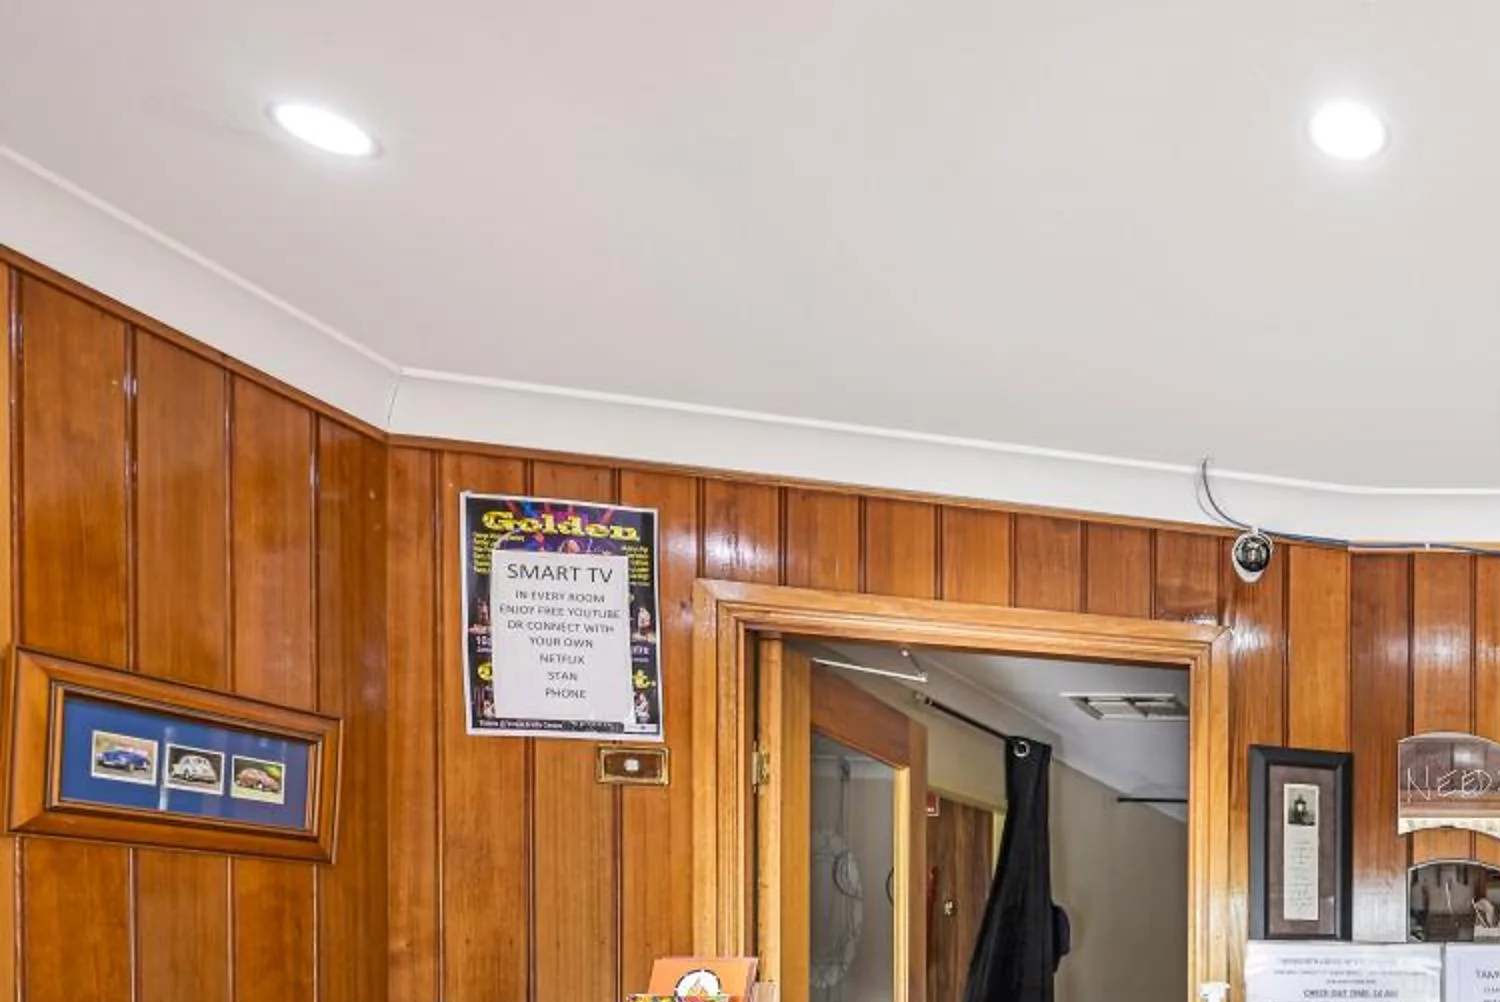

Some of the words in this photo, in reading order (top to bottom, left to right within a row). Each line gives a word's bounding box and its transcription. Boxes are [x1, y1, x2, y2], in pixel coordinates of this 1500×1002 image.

[482, 511, 640, 542] Golden
[507, 563, 579, 583] SMART
[588, 567, 614, 584] TV
[531, 591, 564, 601] EVERY
[569, 593, 605, 603] ROOM
[499, 604, 534, 616] ENJOY
[537, 606, 565, 617] FREE
[568, 608, 621, 620] YOUTUBE
[527, 621, 580, 633] CONNECT
[584, 624, 615, 635] WITH
[529, 636, 561, 648] YOUR
[563, 638, 593, 649] OWN
[539, 653, 586, 665] NETFLIX
[547, 671, 578, 681] STAN
[545, 687, 587, 699] PHONE
[1407, 765, 1493, 803] NEED
